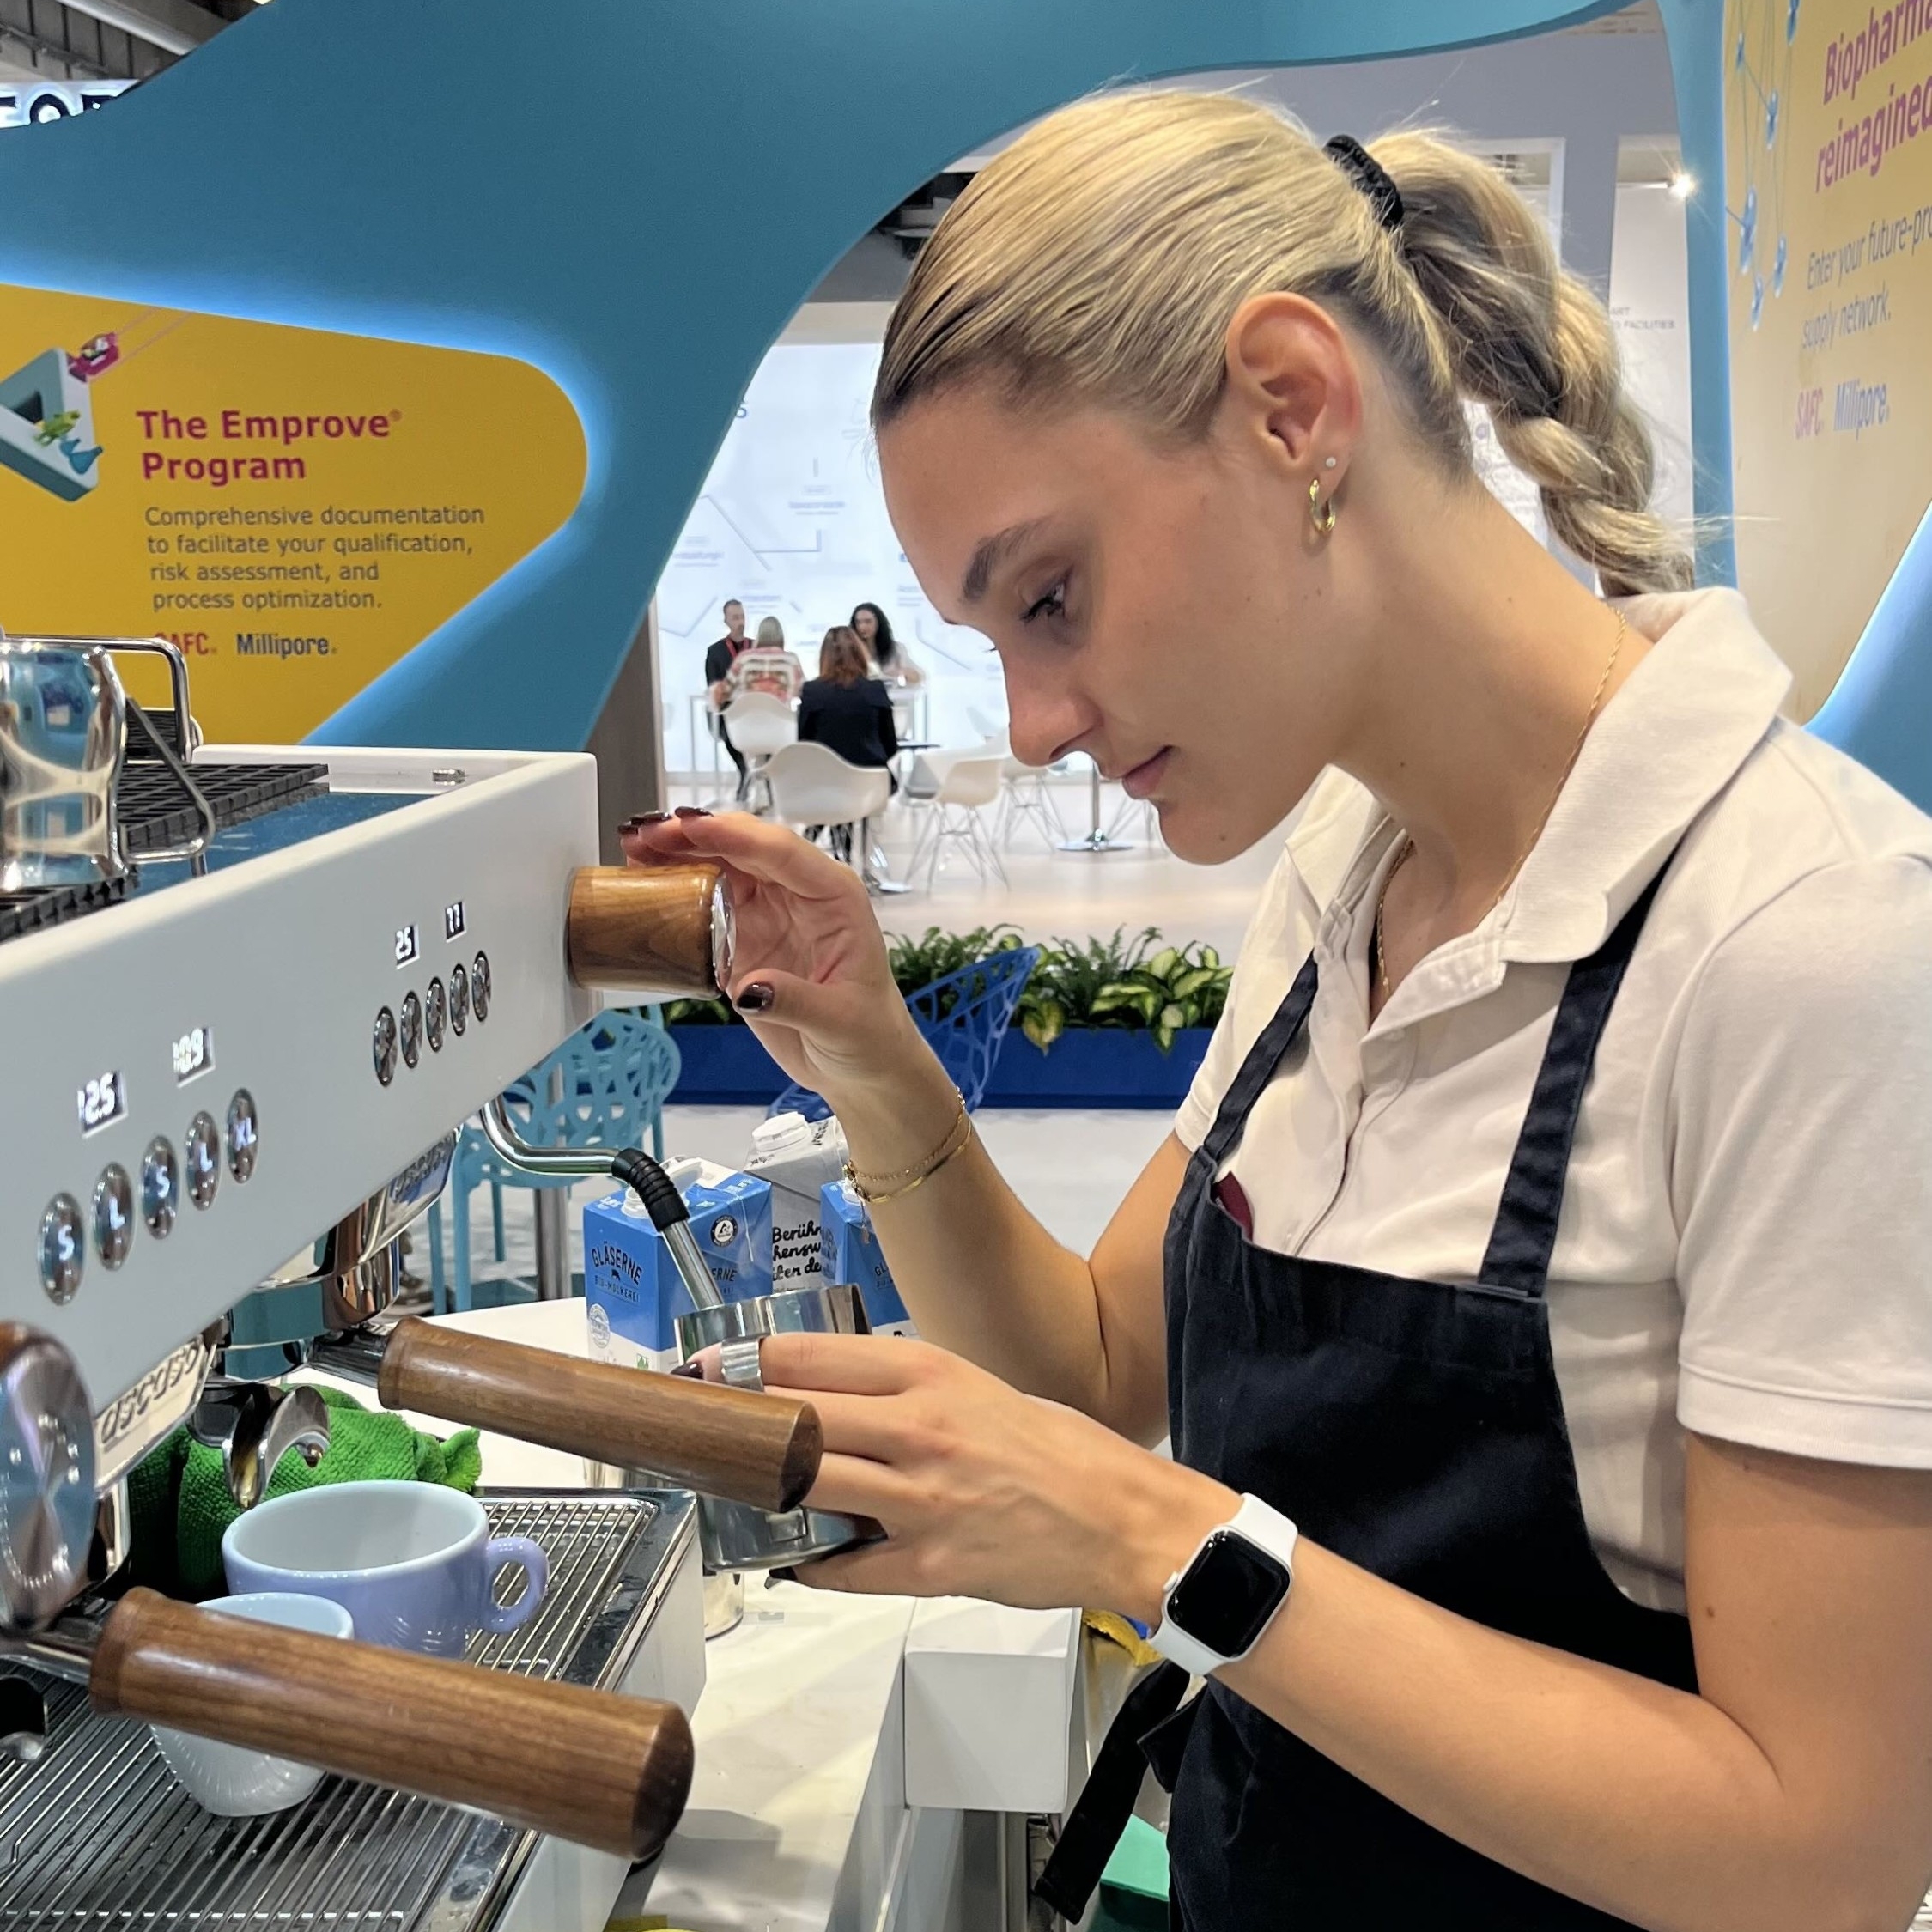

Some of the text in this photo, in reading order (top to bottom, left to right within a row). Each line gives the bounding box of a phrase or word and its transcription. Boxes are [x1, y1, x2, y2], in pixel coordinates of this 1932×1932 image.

[1807, 249, 1836, 290] Enter
[1838, 236, 1866, 287] your
[136, 410, 208, 440] The
[142, 452, 306, 487] Program
[145, 506, 484, 529] Comprehensive documentation
[147, 533, 473, 556] to facilitate your qualification,
[151, 562, 379, 583] risk assessment, and
[153, 590, 382, 612] process optimization.
[58, 1224, 75, 1261] S
[109, 1195, 125, 1230] L
[155, 1165, 170, 1198] S
[199, 1142, 214, 1172] L
